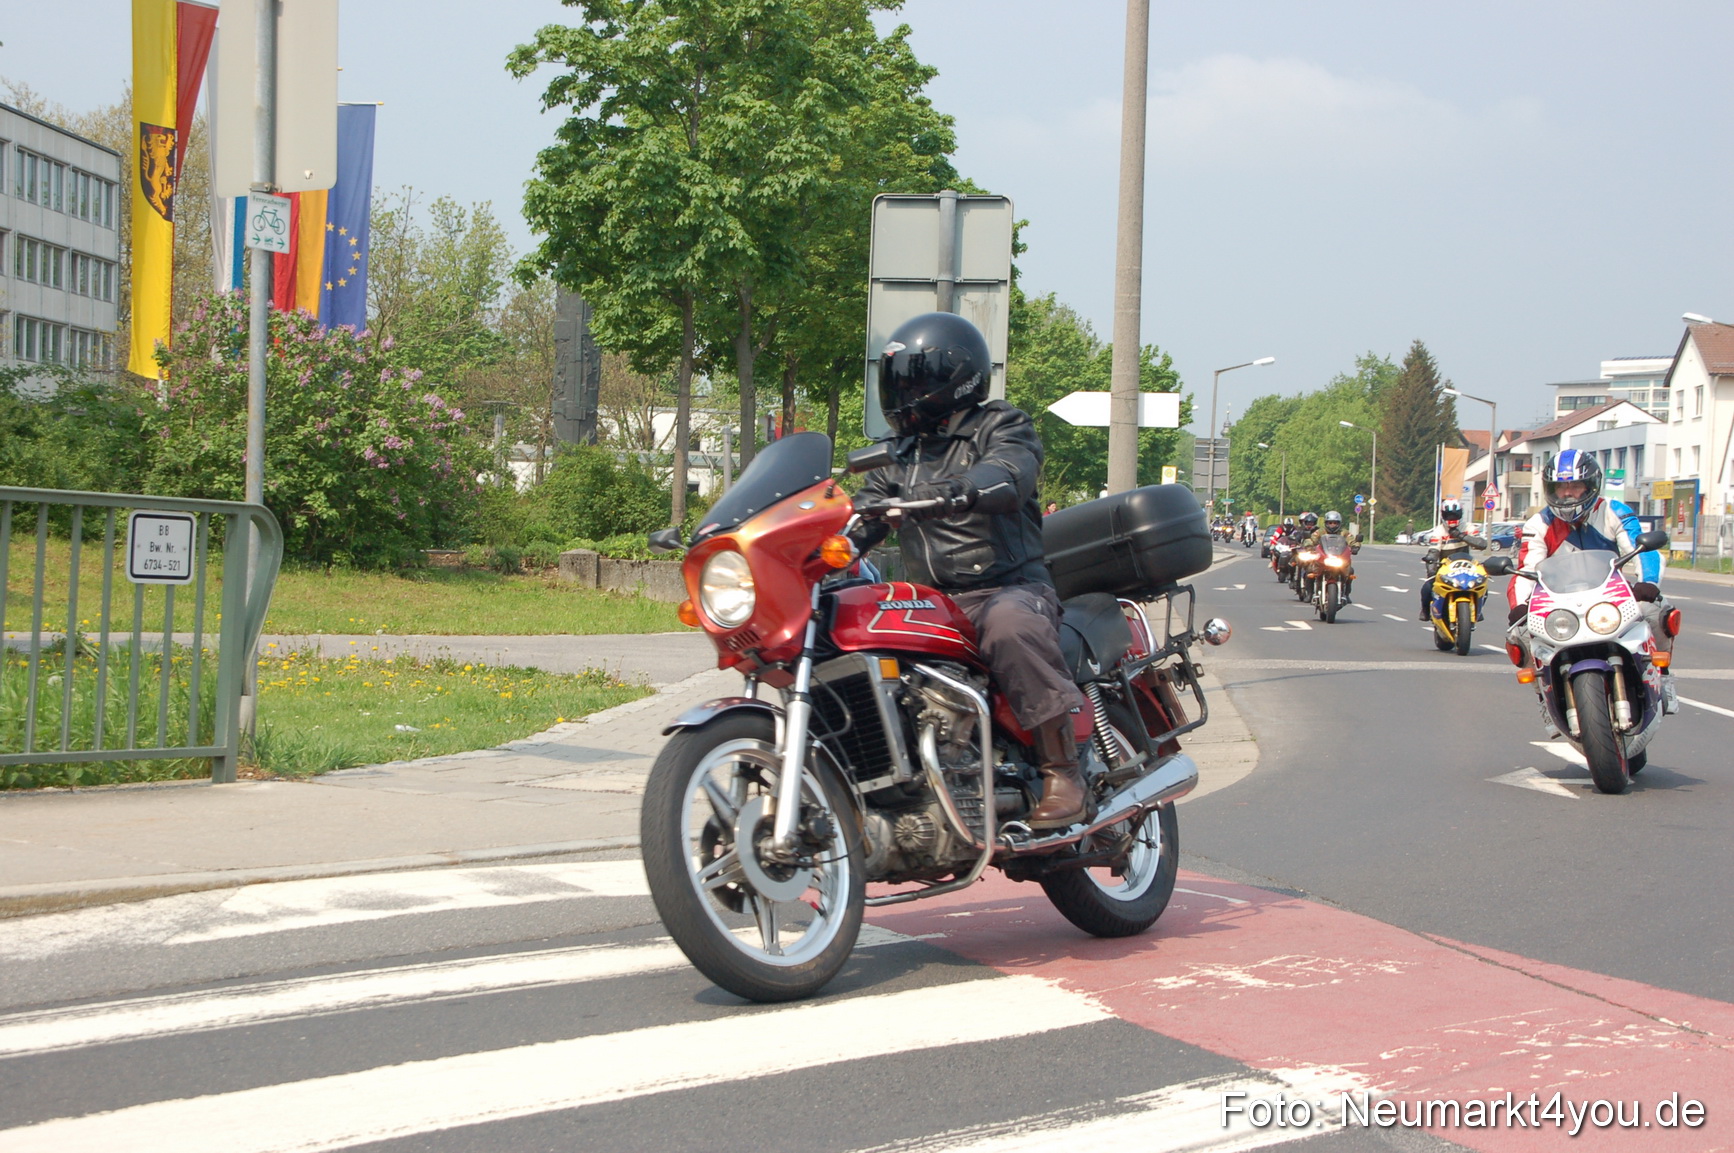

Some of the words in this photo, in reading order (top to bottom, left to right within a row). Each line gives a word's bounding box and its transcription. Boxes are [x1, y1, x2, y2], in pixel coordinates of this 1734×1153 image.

[159, 525, 170, 536] BB
[166, 542, 177, 554] Nr.
[144, 559, 181, 571] 6734-521
[877, 599, 937, 610] HONDA
